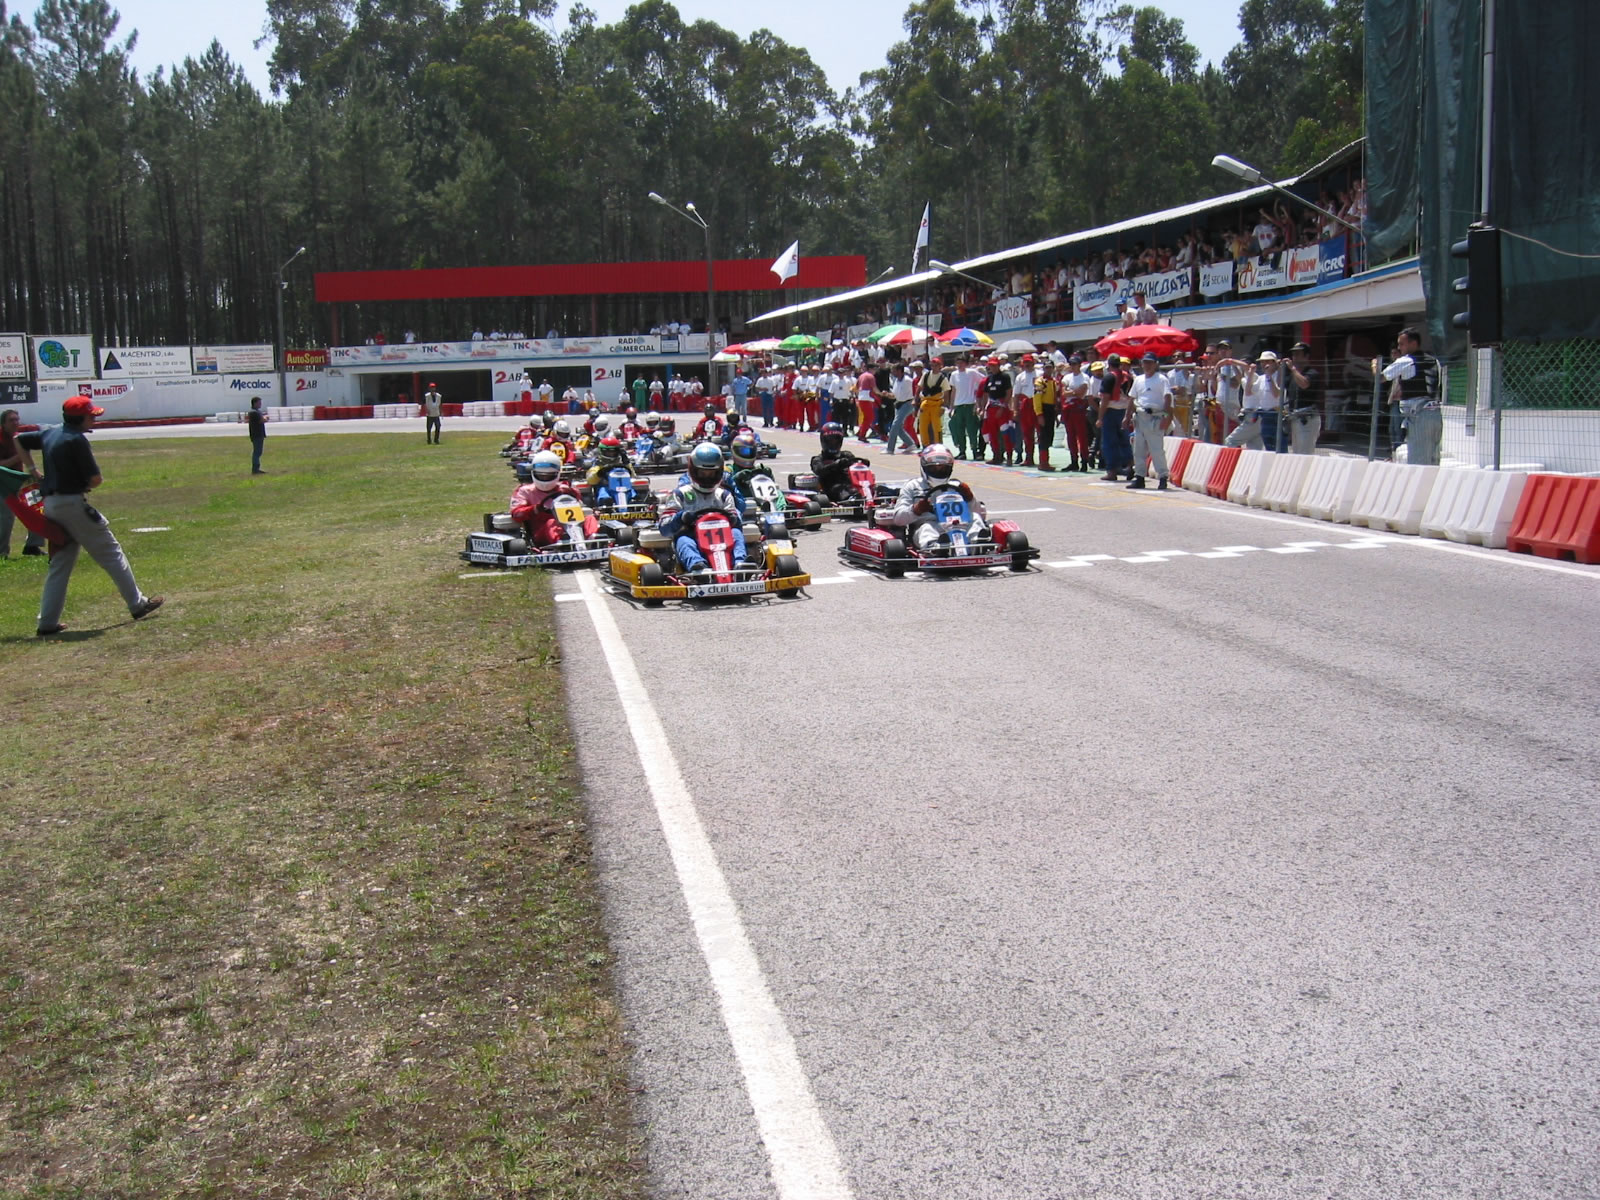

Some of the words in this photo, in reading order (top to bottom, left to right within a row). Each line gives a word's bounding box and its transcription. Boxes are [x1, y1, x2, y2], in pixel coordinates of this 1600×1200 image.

[120, 350, 161, 358] MACENTRO
[334, 349, 350, 357] TNC
[422, 345, 438, 353] TNC
[287, 352, 325, 365] AutoSport
[230, 379, 271, 390] Mecalac
[756, 485, 777, 497] 12
[940, 502, 964, 516] 20
[565, 509, 576, 522] 2
[703, 528, 725, 544] 11
